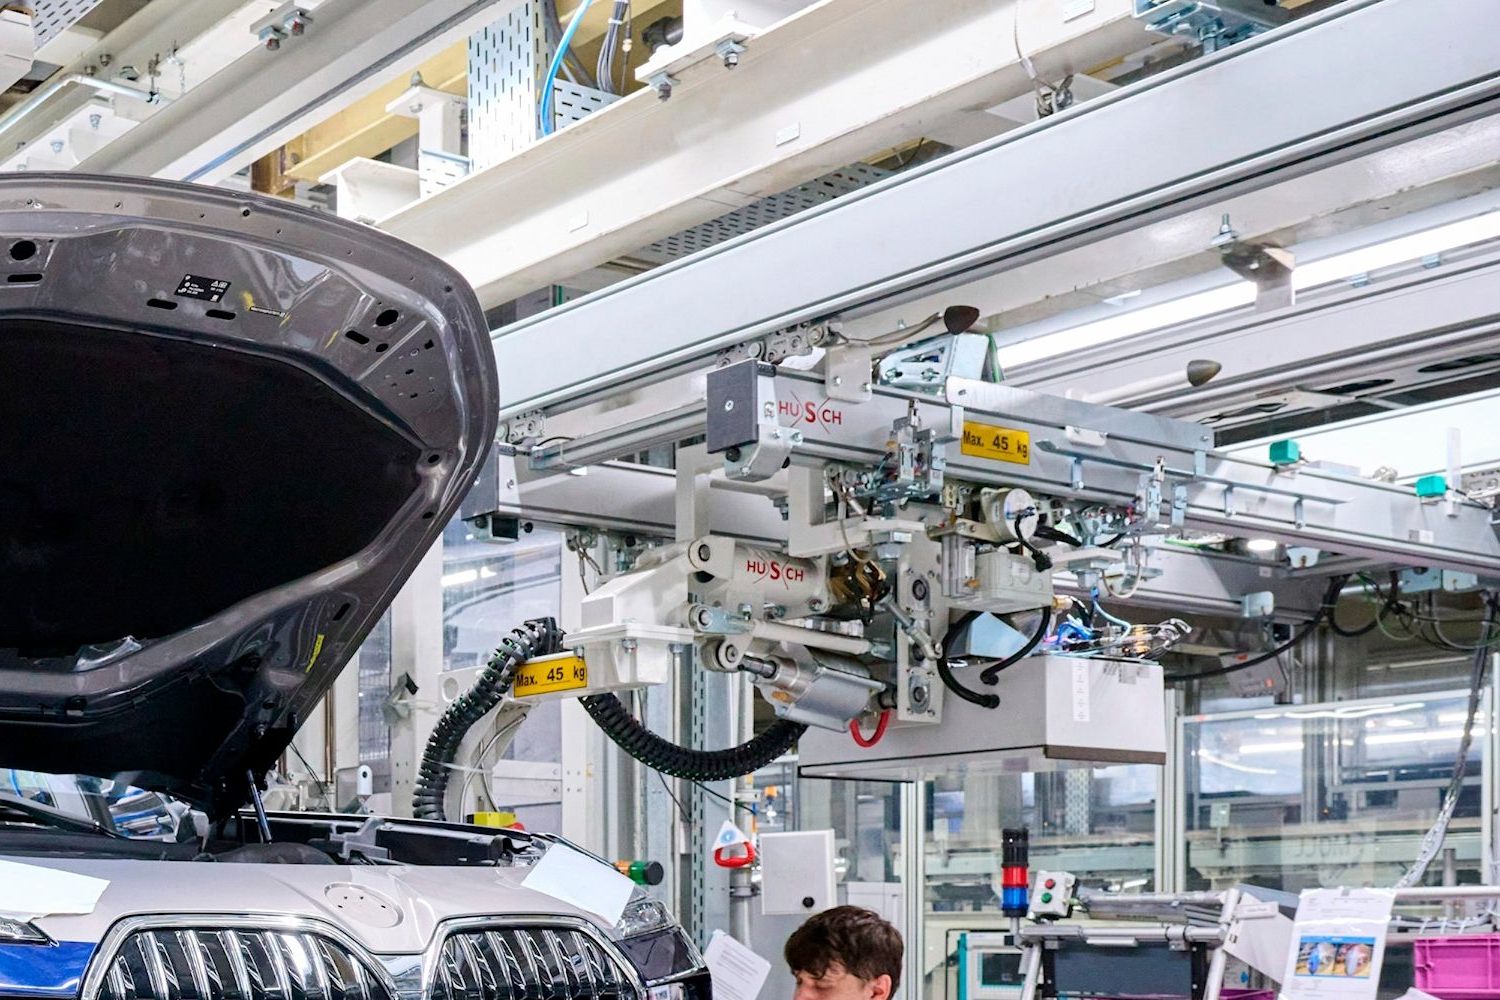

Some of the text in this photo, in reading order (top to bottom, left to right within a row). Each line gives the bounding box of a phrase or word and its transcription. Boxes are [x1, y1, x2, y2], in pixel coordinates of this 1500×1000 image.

[963, 430, 1027, 458] Max. 45 kg
[516, 665, 585, 688] Max. 45 kg
